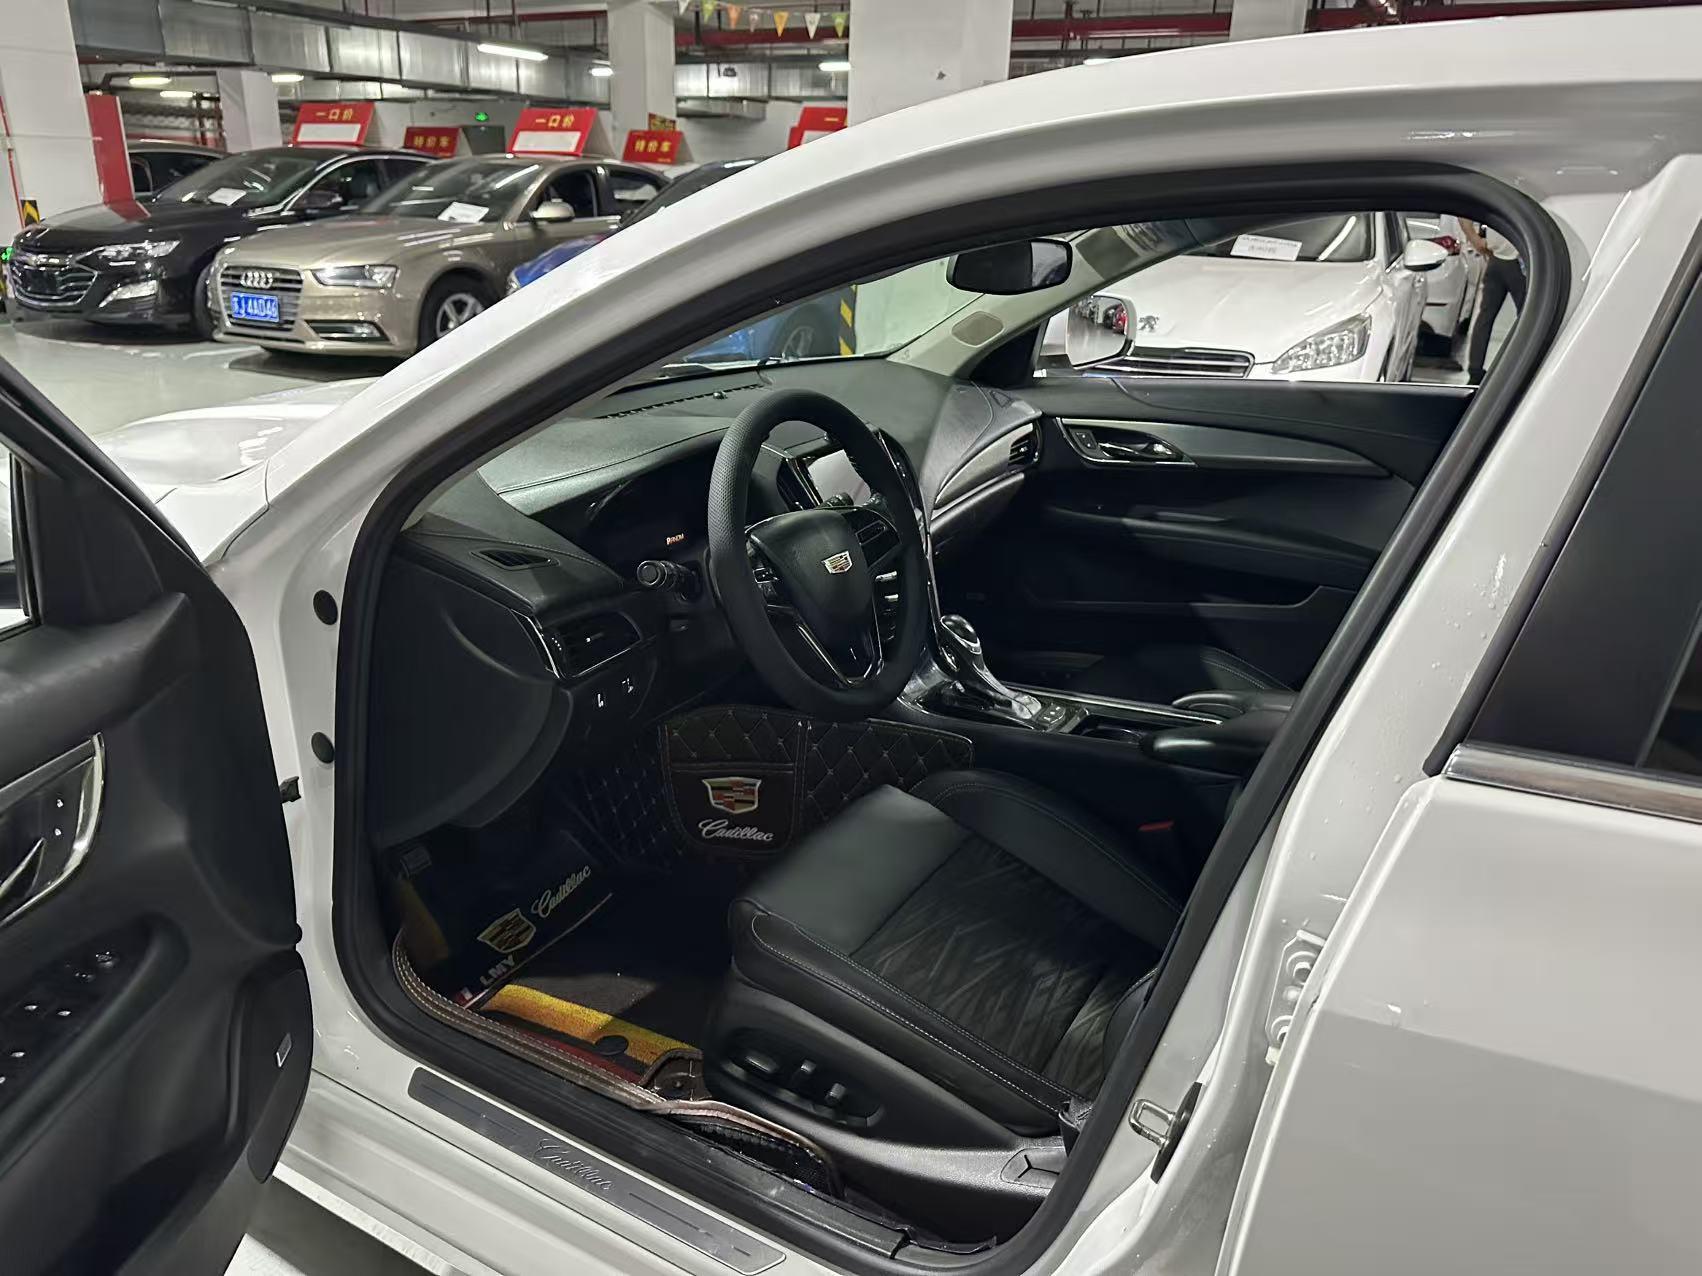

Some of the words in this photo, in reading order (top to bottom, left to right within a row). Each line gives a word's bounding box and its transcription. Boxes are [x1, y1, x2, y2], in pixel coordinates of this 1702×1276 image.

[315, 108, 353, 121] 一口价
[535, 114, 575, 128] 一口价
[634, 138, 673, 153] 特价车
[697, 818, 775, 842] Cadillac
[530, 865, 592, 919] Cadillac
[532, 1138, 613, 1191] Cadillac
